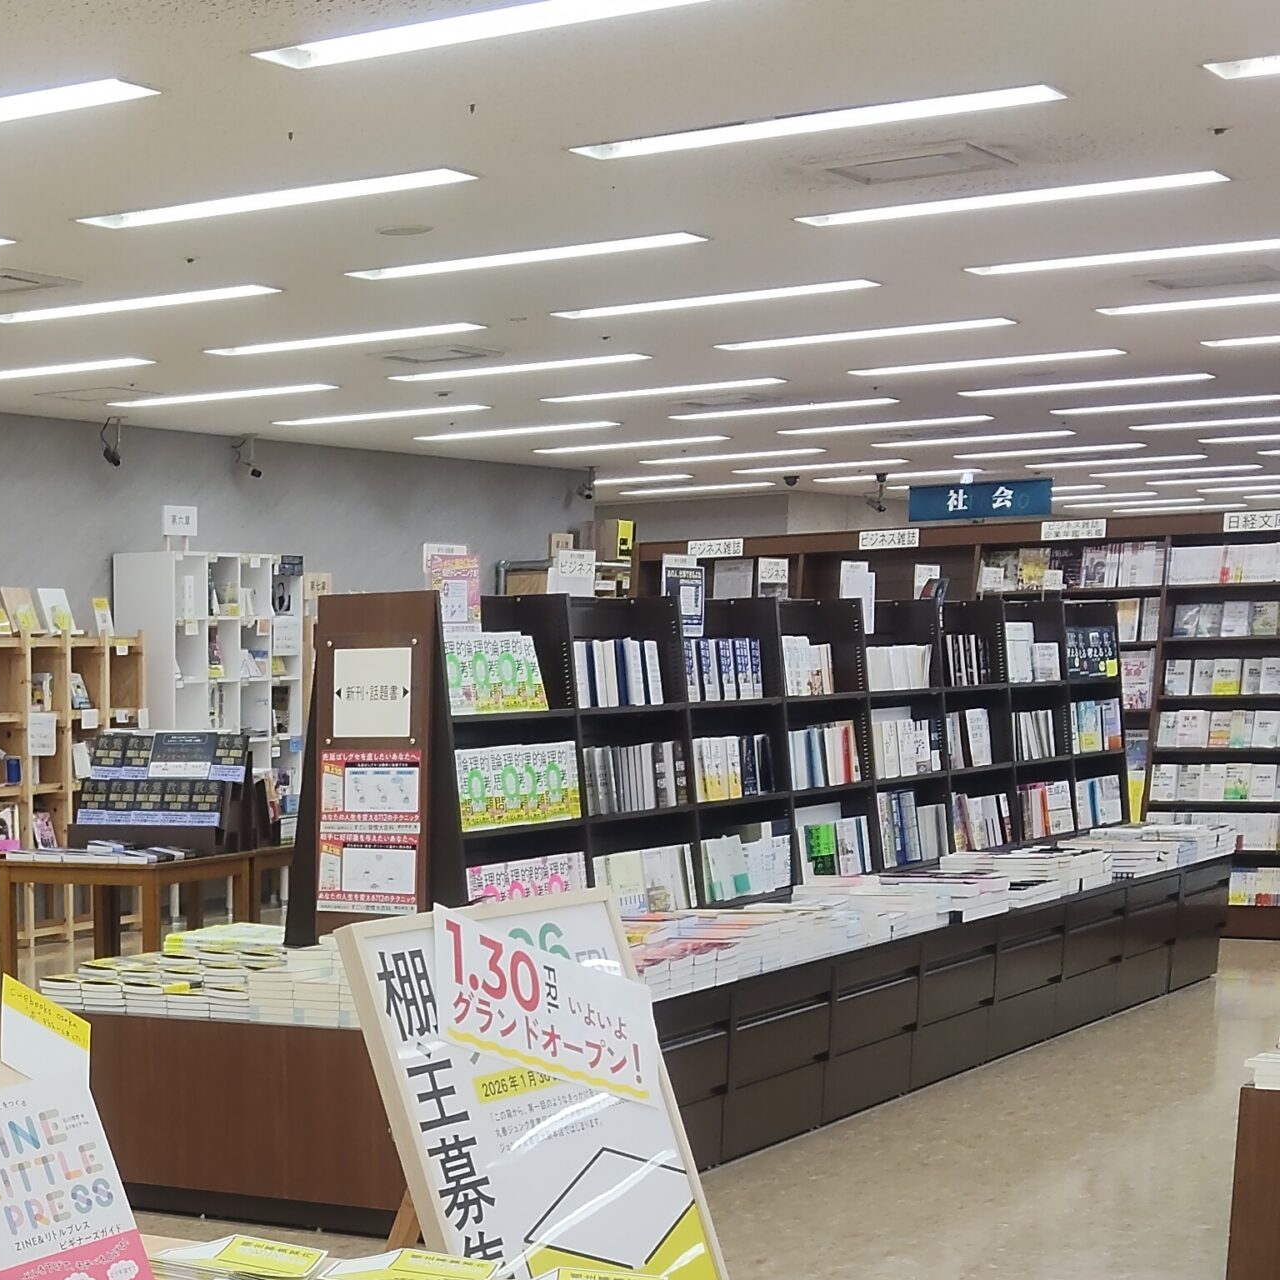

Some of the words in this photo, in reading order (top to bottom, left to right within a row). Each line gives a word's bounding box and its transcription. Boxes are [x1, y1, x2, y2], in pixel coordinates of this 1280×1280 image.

[689, 541, 742, 557] ビジネス雑誌
[861, 530, 917, 547] ビジネス雑誌
[560, 560, 594, 575] ビジネス
[760, 567, 787, 580] ビジネス
[346, 685, 398, 701] 新刊・話題書
[445, 918, 541, 1012] 1.30
[543, 964, 560, 1014] FRI.
[568, 996, 628, 1041] いよいよ
[4, 1178, 114, 1236] PRESS
[14, 1221, 91, 1251] ZINE&リトルプレス
[59, 1224, 122, 1250] ビギナーズガイド
